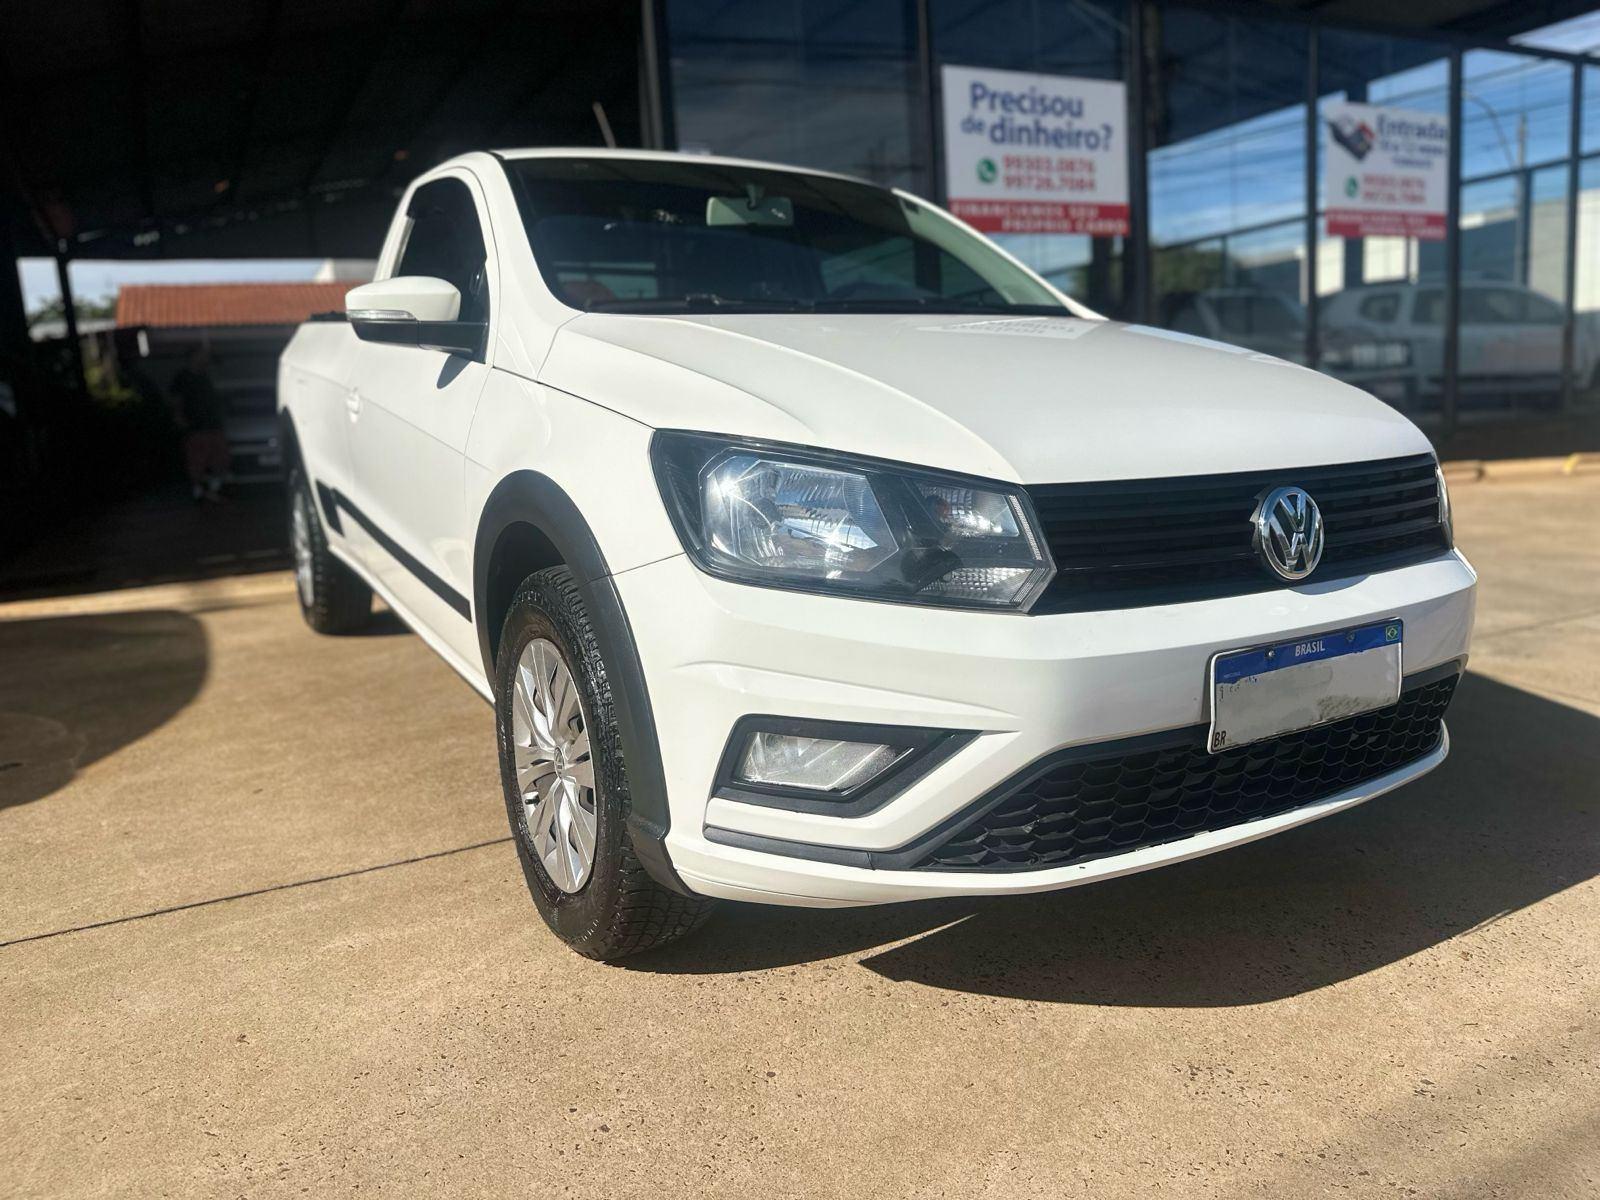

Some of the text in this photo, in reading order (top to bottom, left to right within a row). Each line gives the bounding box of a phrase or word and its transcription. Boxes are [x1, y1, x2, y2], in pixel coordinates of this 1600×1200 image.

[970, 81, 1083, 118] Precisou
[960, 115, 1113, 151] de dinheiro?
[1295, 640, 1326, 657] BRASIL
[1213, 730, 1227, 747] BR
